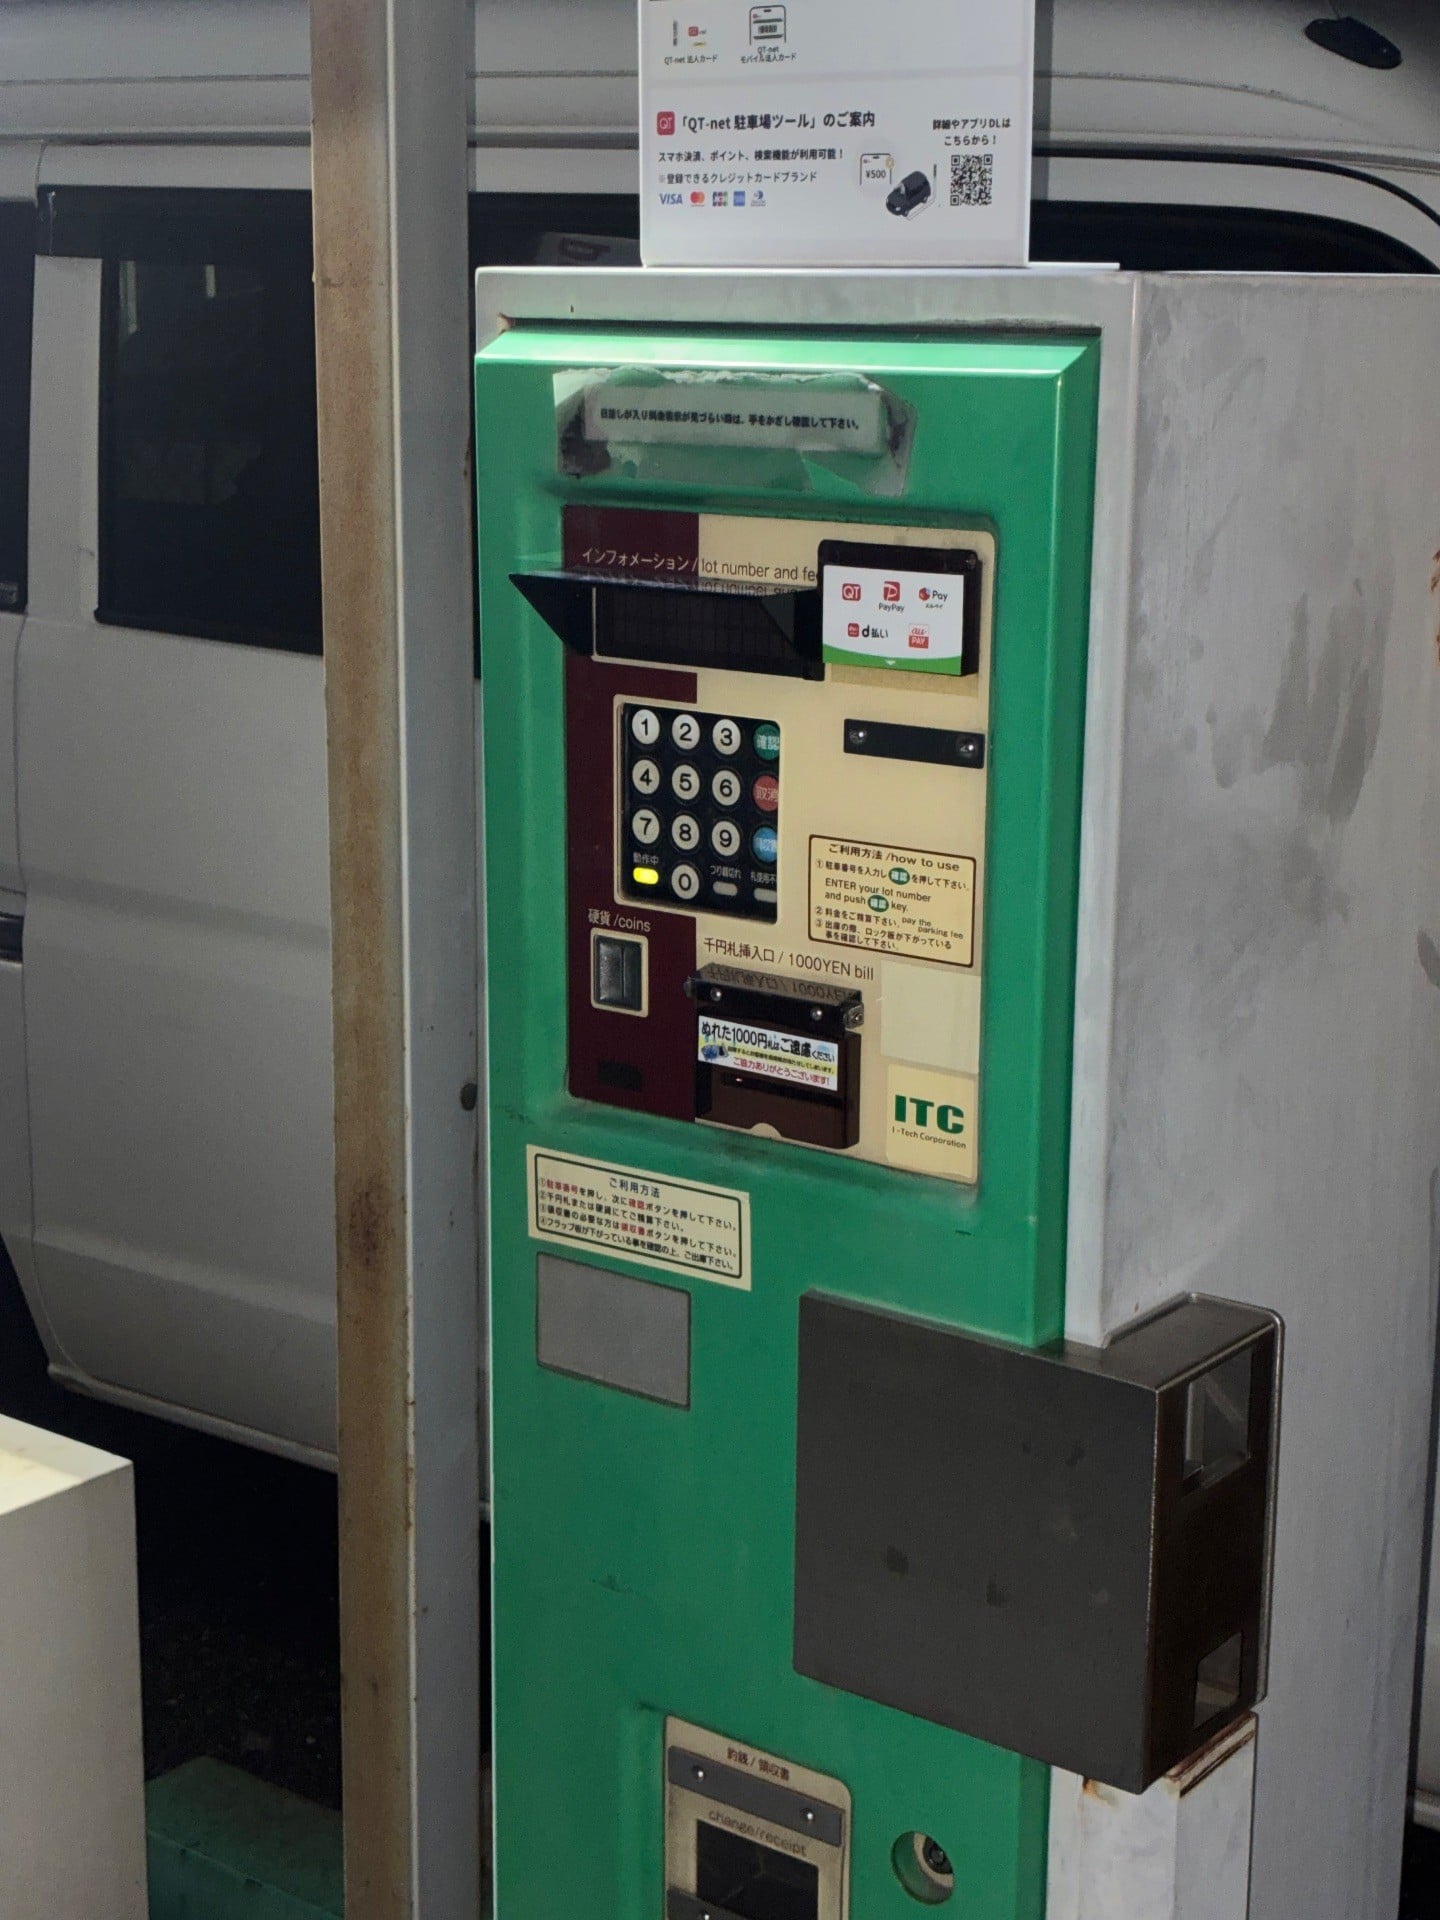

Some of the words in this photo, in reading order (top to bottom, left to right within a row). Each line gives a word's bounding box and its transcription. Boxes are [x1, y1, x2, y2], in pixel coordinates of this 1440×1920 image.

[658, 192, 683, 205] VISA
[582, 547, 689, 570] インフォメーション
[701, 558, 718, 574] lot
[721, 561, 769, 578] number
[774, 564, 798, 581] and
[802, 566, 819, 582] fe
[932, 589, 948, 602] Pay
[878, 603, 905, 612] PayPay
[679, 722, 692, 742] 2
[720, 727, 733, 747] 3
[640, 768, 652, 787] 4
[679, 773, 692, 792] 5
[719, 778, 733, 798] 6
[640, 817, 651, 836] 7
[679, 823, 692, 842] 8
[719, 829, 732, 848] 9
[829, 843, 882, 861] ご利用方法
[921, 858, 933, 868] to
[937, 860, 960, 872] use
[678, 873, 692, 892] 0
[825, 878, 856, 891] ENTER
[858, 883, 880, 895] your
[882, 886, 893, 897] lot
[896, 890, 932, 903] number
[824, 890, 841, 901] and
[844, 894, 866, 906] push
[588, 908, 610, 926] 硬貨
[902, 916, 916, 926] pay
[918, 918, 932, 927] the
[918, 926, 948, 938] parking
[950, 929, 964, 940] fee
[703, 936, 775, 962] 千円札挿入口
[788, 952, 851, 977] 1000YEN
[854, 960, 875, 982] bill
[894, 1094, 964, 1134] ITC
[920, 1132, 966, 1150] Corporation
[609, 1176, 660, 1199] ご利用方法
